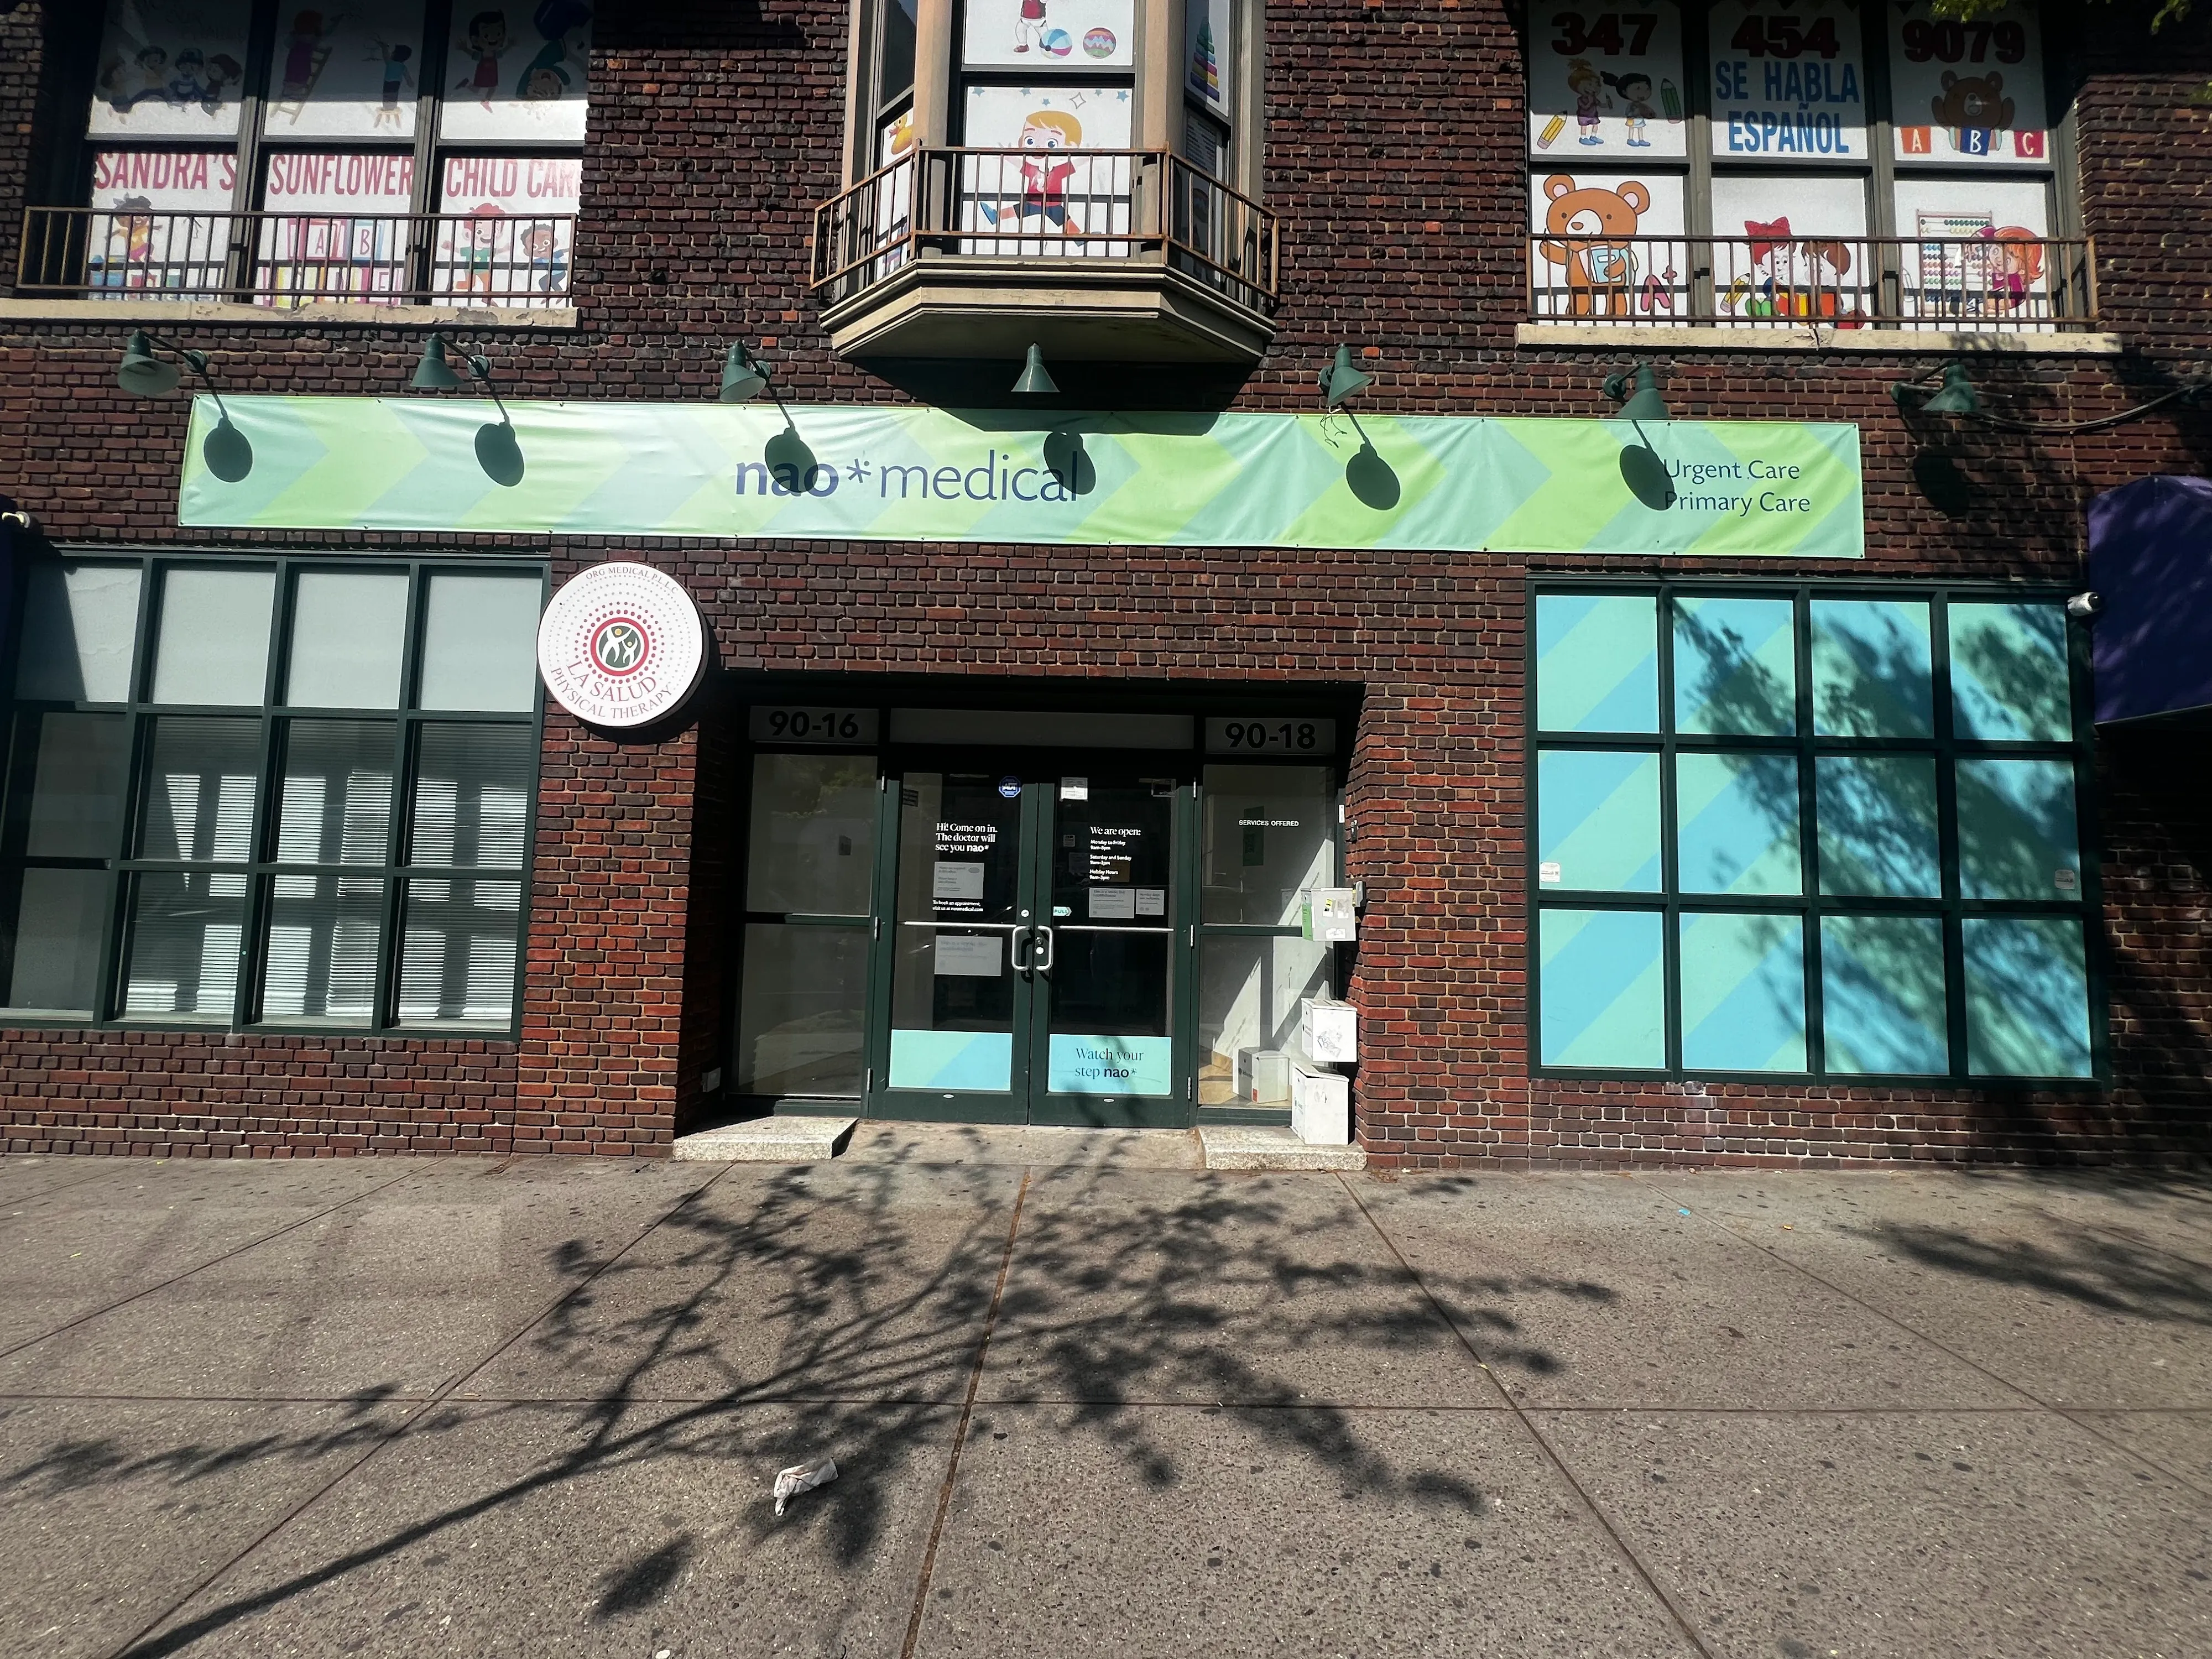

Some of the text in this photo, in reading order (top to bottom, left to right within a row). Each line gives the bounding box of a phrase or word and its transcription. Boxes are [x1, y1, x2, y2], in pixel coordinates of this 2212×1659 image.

[1551, 12, 2025, 64] 347 454 9079
[1715, 61, 1860, 103] SE HABLA
[1728, 102, 1849, 153] ESPAÑOL
[1912, 129, 2034, 155] A B C
[95, 153, 582, 197] SANDRA'S SUNFLOWER CHILD CAR
[360, 229, 371, 255] B
[880, 450, 1077, 502] medical
[1664, 459, 1800, 484] Urgent Care
[1665, 491, 1810, 517] Primary Care
[586, 568, 605, 580] ORG
[608, 566, 649, 578] MEDICAL
[551, 667, 672, 719] PHYSICAL THERAPY
[566, 661, 656, 702] LA SALUD
[769, 710, 858, 738] 90-16
[1225, 722, 1316, 749] 90-18
[936, 822, 948, 831] Hi!
[950, 823, 973, 832] Come
[987, 824, 998, 833] in.
[936, 833, 995, 842] The doctor will
[1089, 826, 1103, 835] We
[1118, 828, 1141, 837] open:
[950, 844, 964, 853] you
[1076, 1048, 1144, 1063] Watch your
[1075, 1067, 1100, 1079] step
